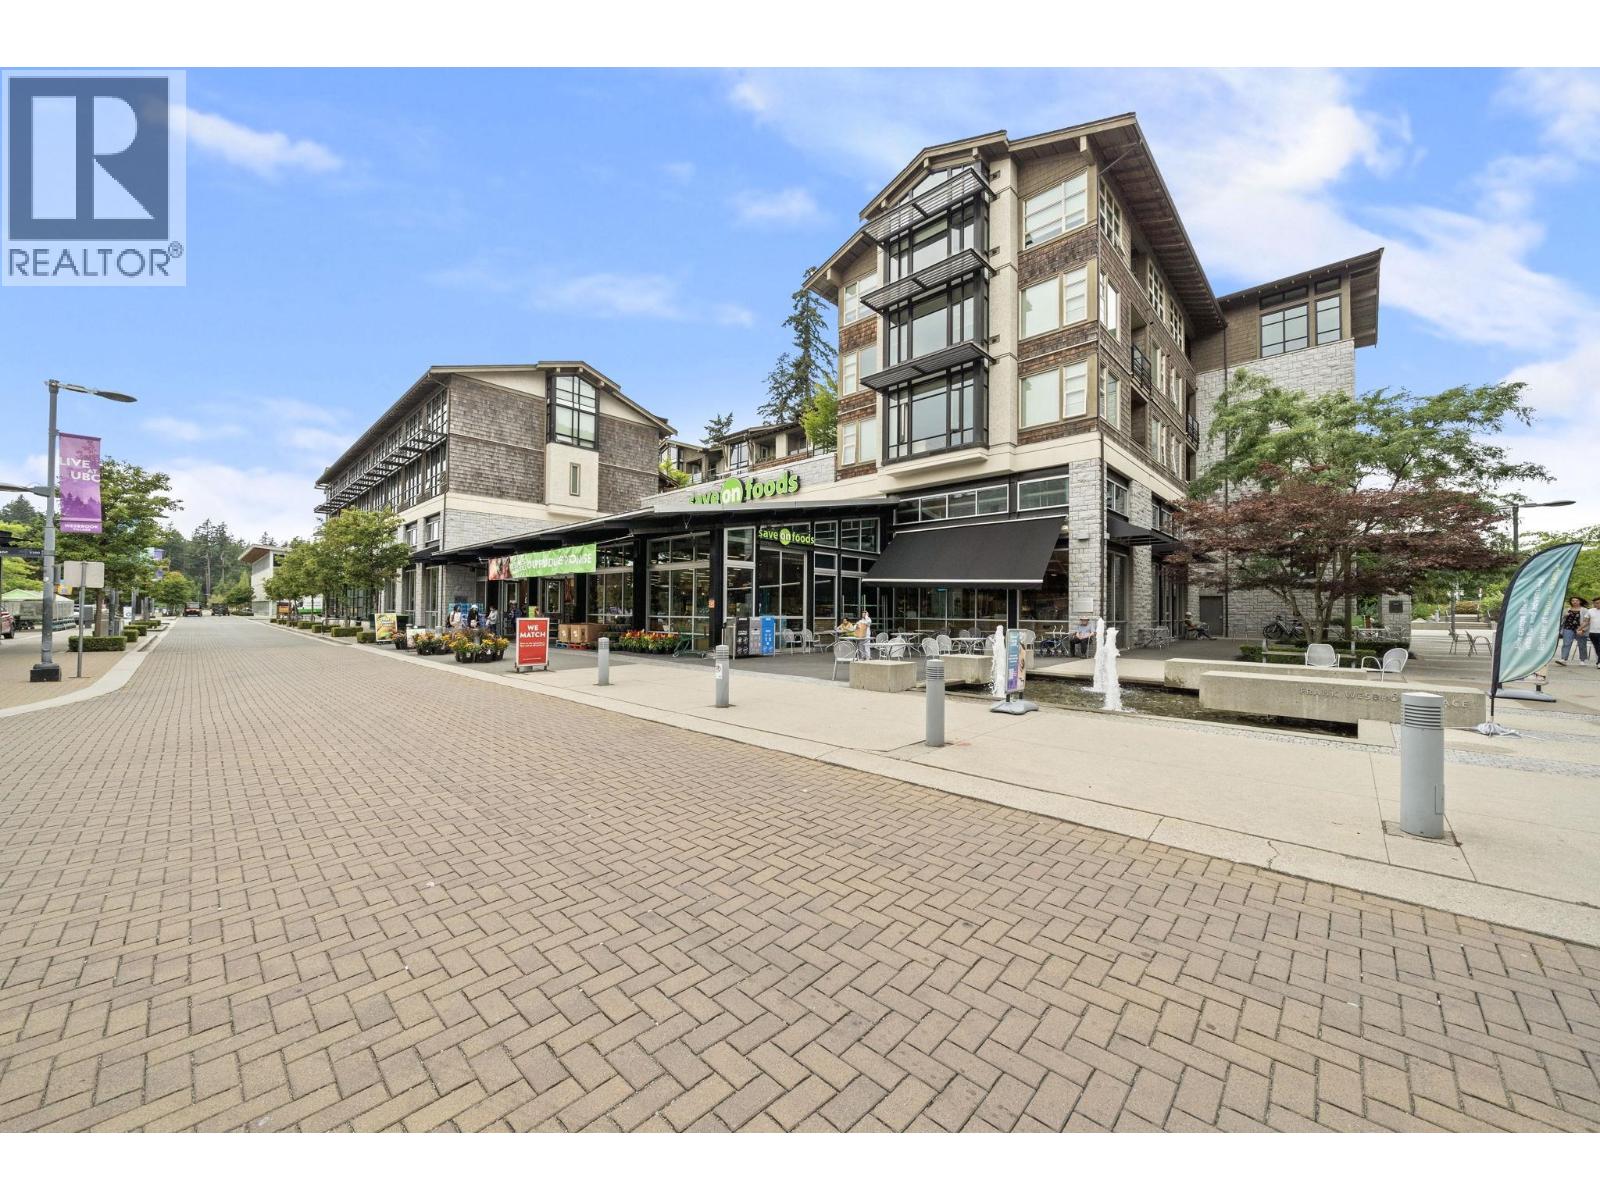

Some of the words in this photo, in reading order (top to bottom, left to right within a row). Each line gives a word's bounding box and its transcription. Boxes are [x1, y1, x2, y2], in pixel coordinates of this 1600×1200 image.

[60, 457, 90, 468] LIVE
[71, 471, 101, 482] UBC
[721, 486, 742, 504] on
[745, 470, 799, 500] foods
[758, 528, 779, 540] save
[780, 531, 791, 541] on
[792, 533, 815, 545] foods
[1300, 687, 1339, 699] FRANK
[1344, 688, 1400, 703] WESBRO
